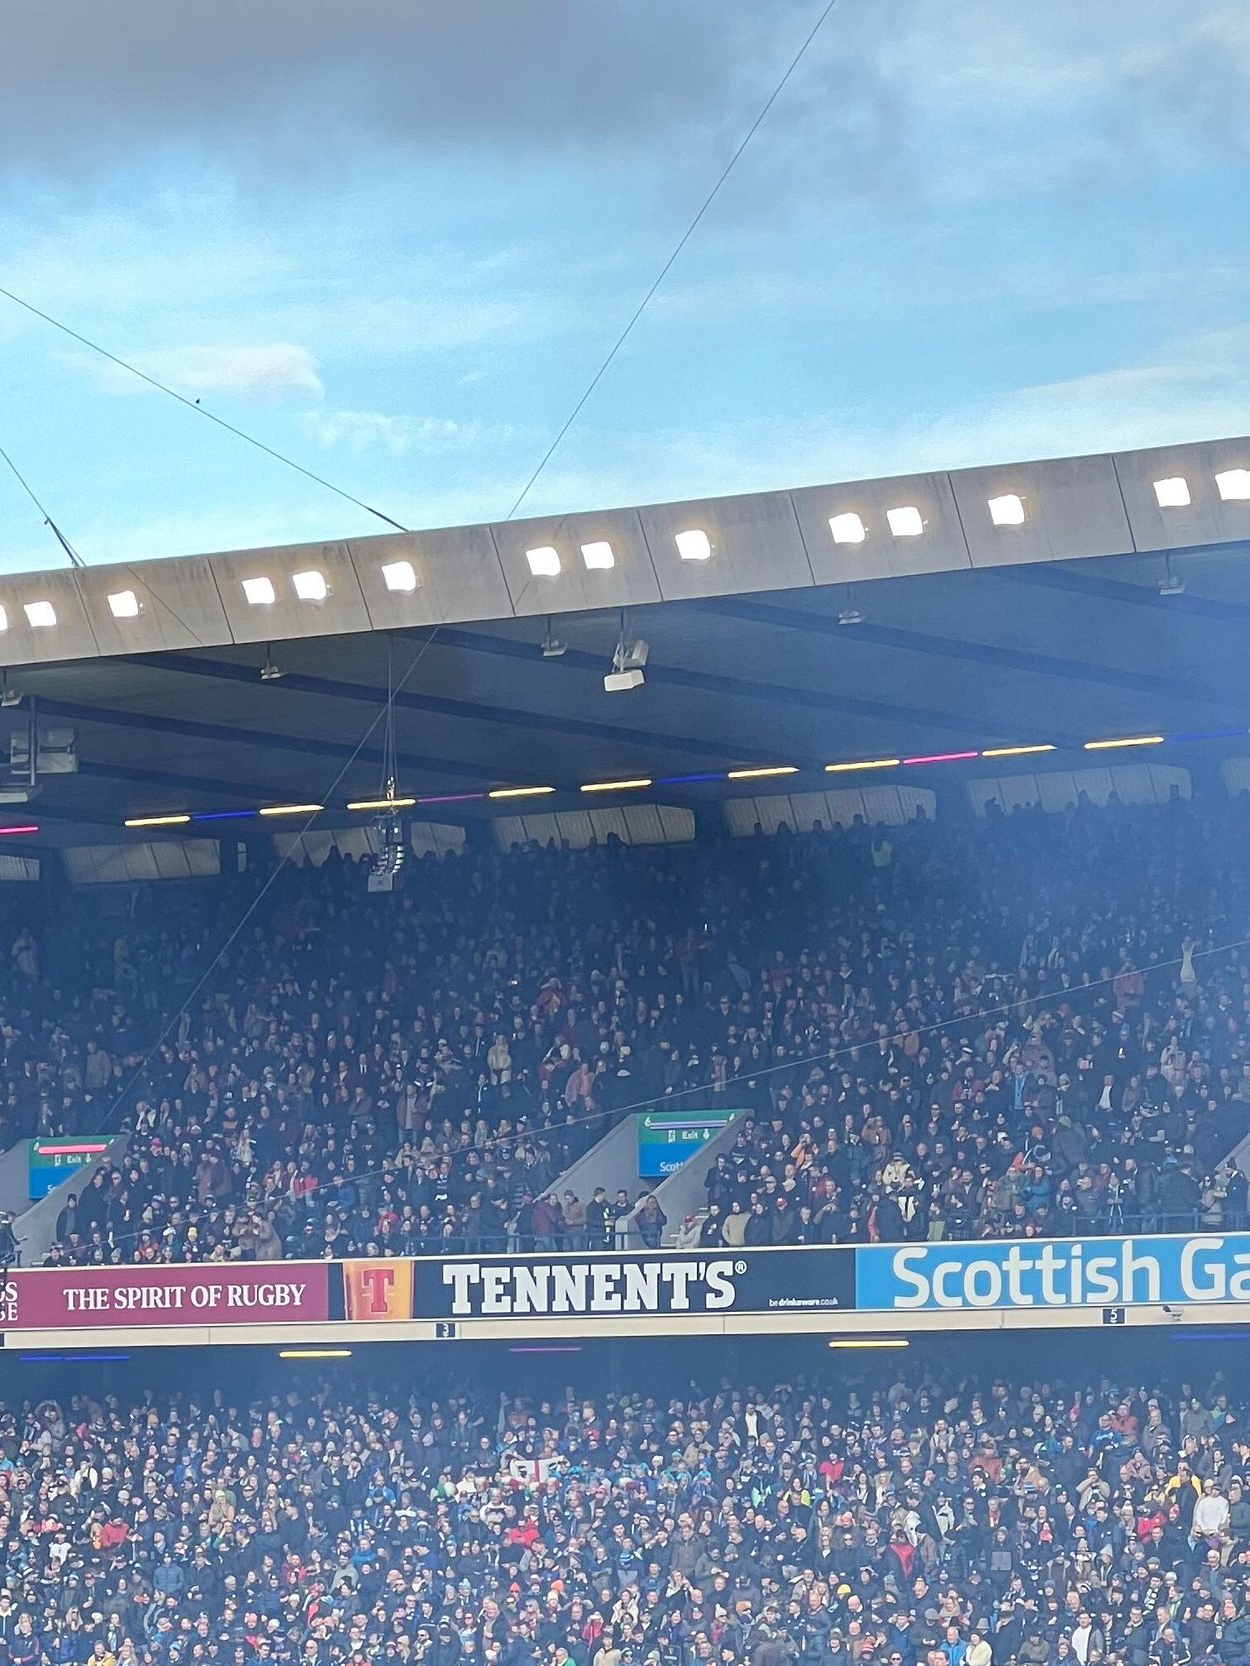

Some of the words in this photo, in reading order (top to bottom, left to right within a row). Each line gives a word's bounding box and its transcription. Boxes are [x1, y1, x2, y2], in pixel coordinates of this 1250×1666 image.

[682, 1131, 698, 1140] Exit
[660, 1162, 684, 1172] Scott
[893, 1240, 1161, 1308] Scottish
[63, 1288, 109, 1310] THE
[114, 1286, 186, 1310] SPIRIT
[190, 1285, 222, 1308] OF
[227, 1283, 306, 1307] RUGBY
[362, 1268, 395, 1314] T
[1110, 1308, 1117, 1319] 5
